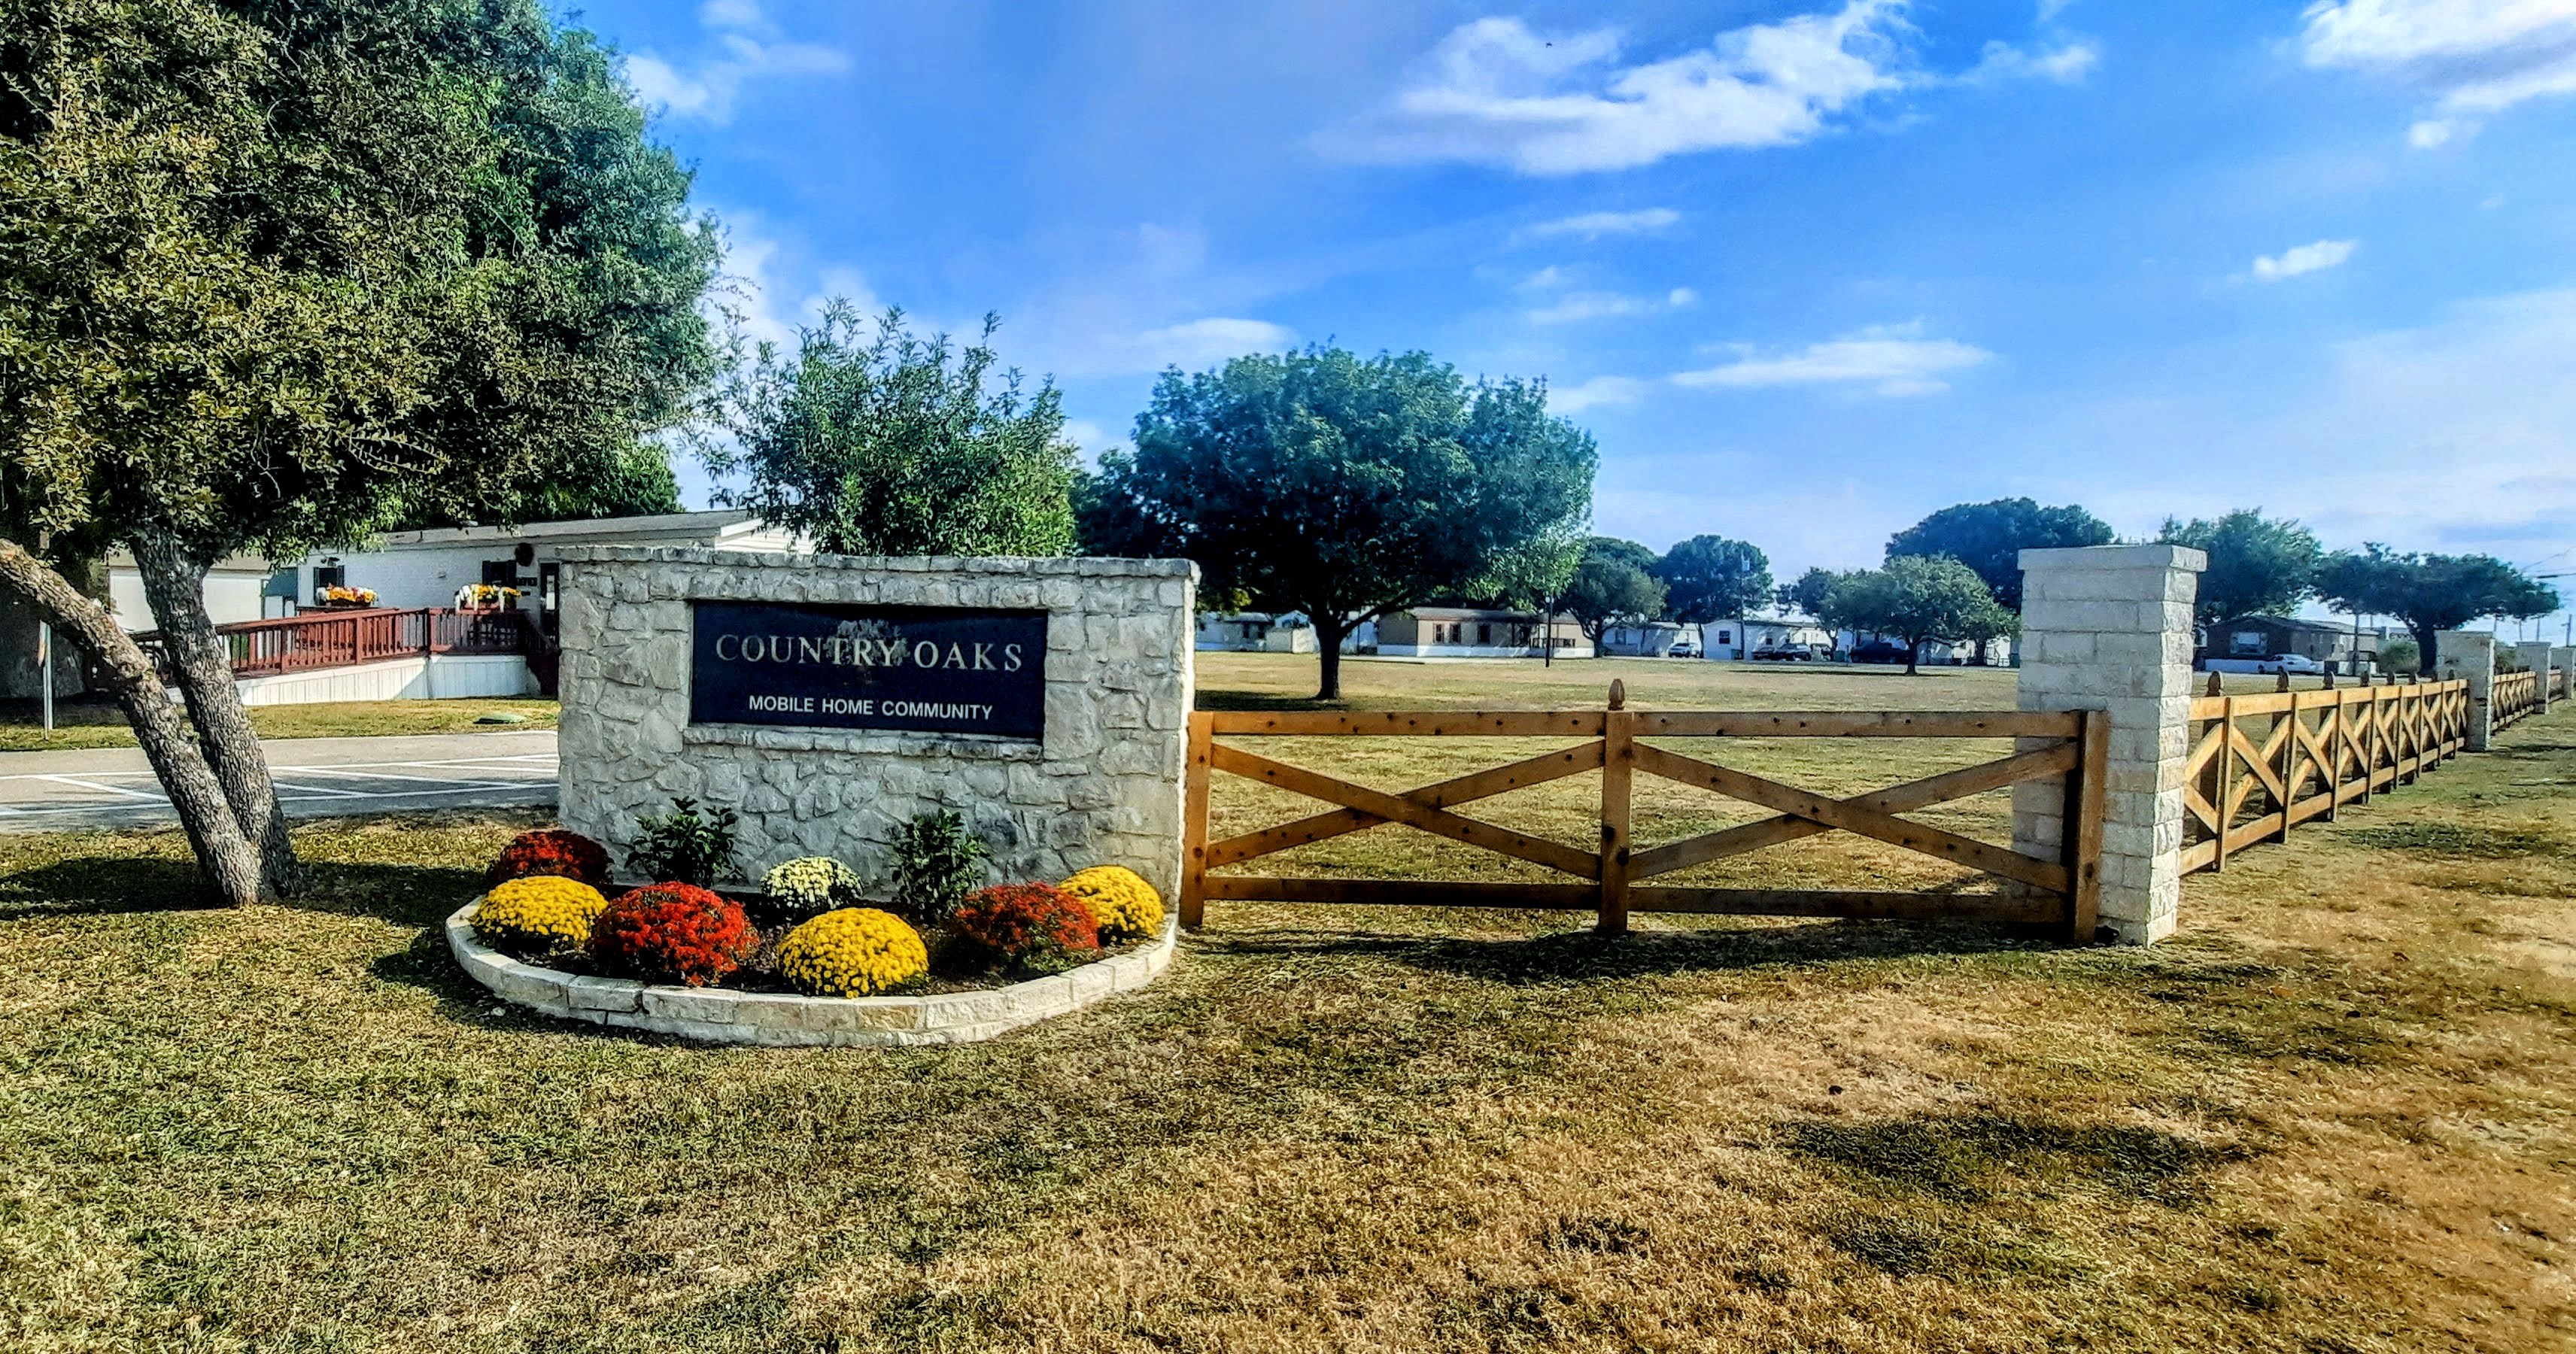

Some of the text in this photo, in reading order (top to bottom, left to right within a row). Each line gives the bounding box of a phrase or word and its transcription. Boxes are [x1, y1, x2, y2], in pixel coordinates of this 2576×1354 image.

[715, 634, 1022, 672] COUNTRY OAKS
[749, 695, 993, 720] MOBILE HOME COMMUNITY
